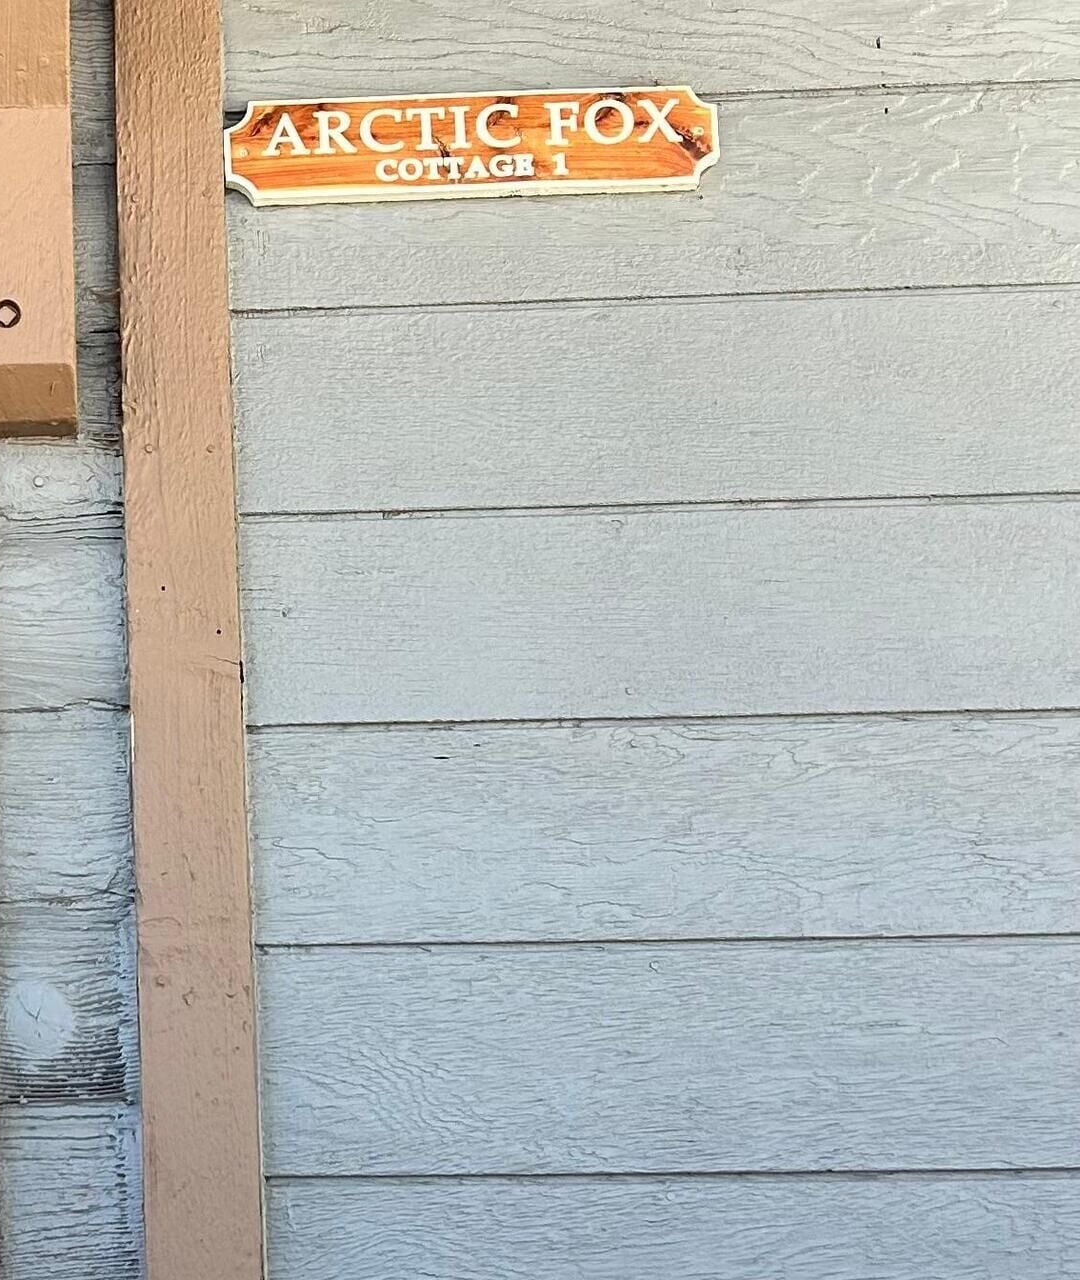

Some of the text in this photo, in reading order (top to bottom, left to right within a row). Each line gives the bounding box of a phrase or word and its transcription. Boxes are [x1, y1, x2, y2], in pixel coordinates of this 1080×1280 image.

[261, 98, 684, 157] ARCTIC FOX
[375, 151, 570, 182] COTTAGE 1
